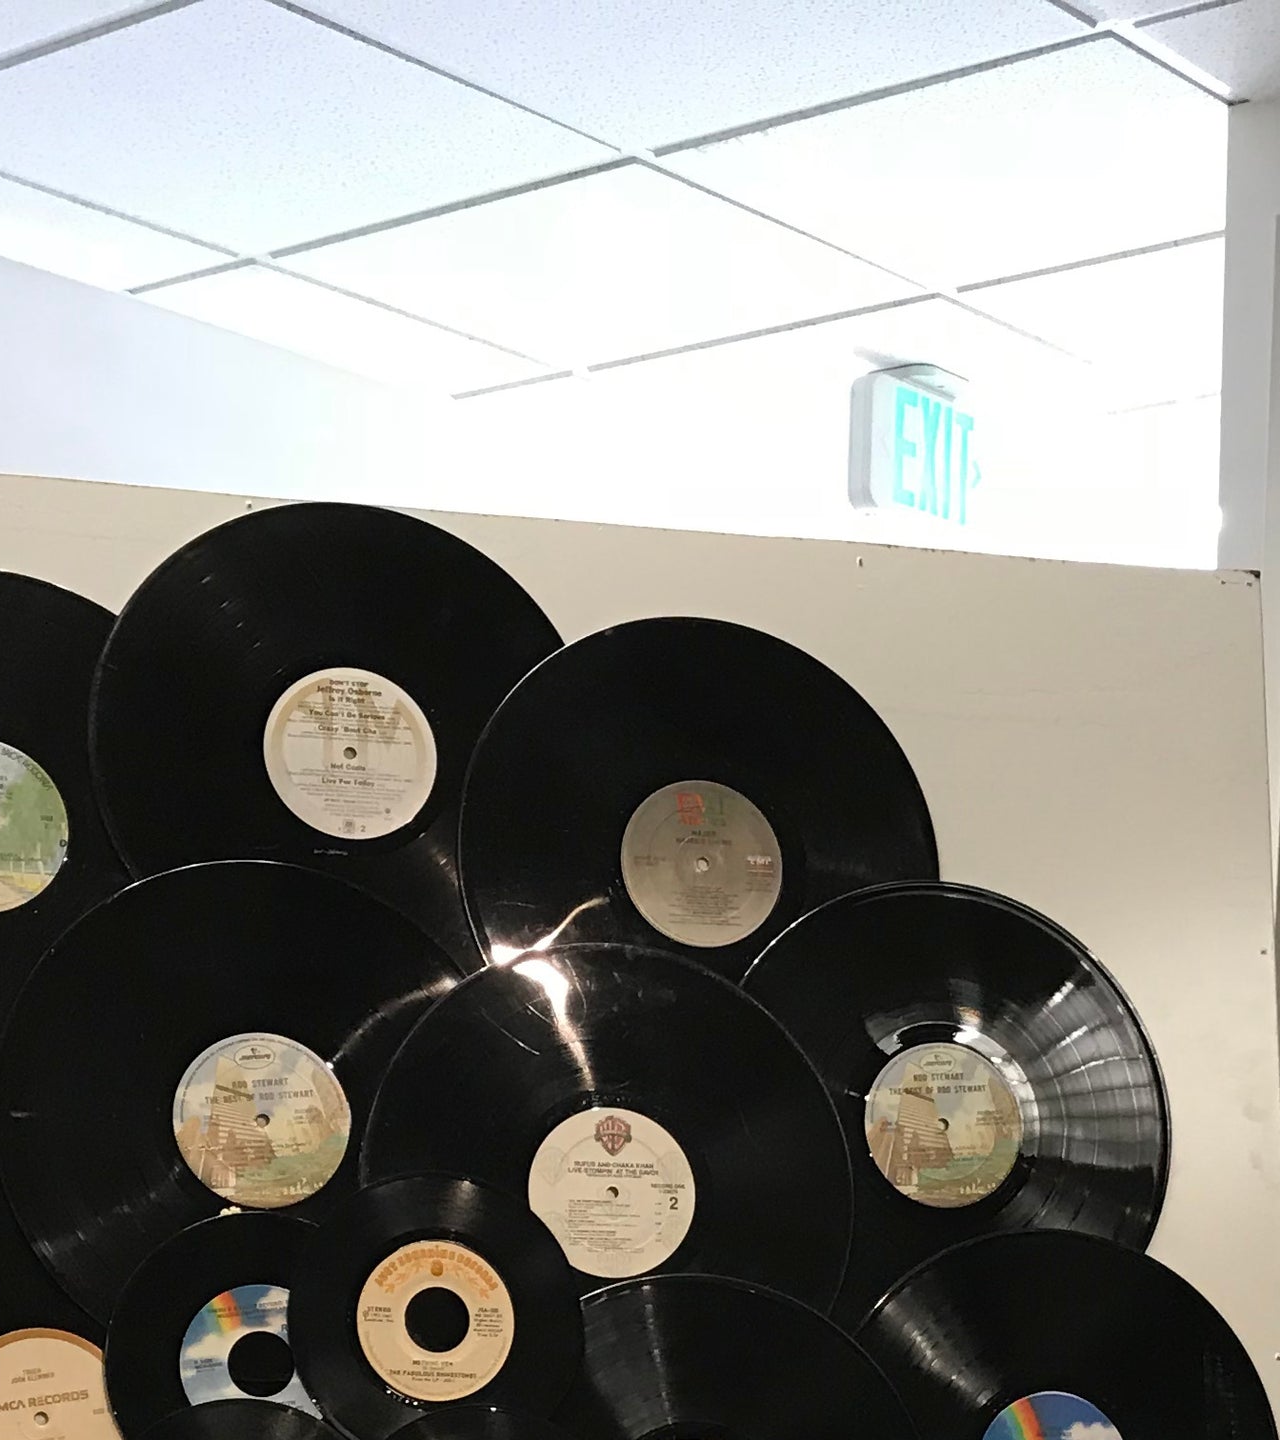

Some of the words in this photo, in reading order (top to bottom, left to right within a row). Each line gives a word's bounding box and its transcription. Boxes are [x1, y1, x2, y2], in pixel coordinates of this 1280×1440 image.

[893, 386, 974, 526] EXIT
[348, 688, 382, 697] Osborne
[360, 825, 366, 833] 2
[931, 1073, 964, 1081] STEWART
[251, 1078, 289, 1087] STEWART
[937, 1086, 951, 1094] ROD
[954, 1085, 986, 1093] STEWART
[259, 1093, 275, 1101] ROD
[278, 1090, 314, 1099] STEWART
[669, 1196, 679, 1210] 2
[28, 1390, 89, 1408] RECORDS
